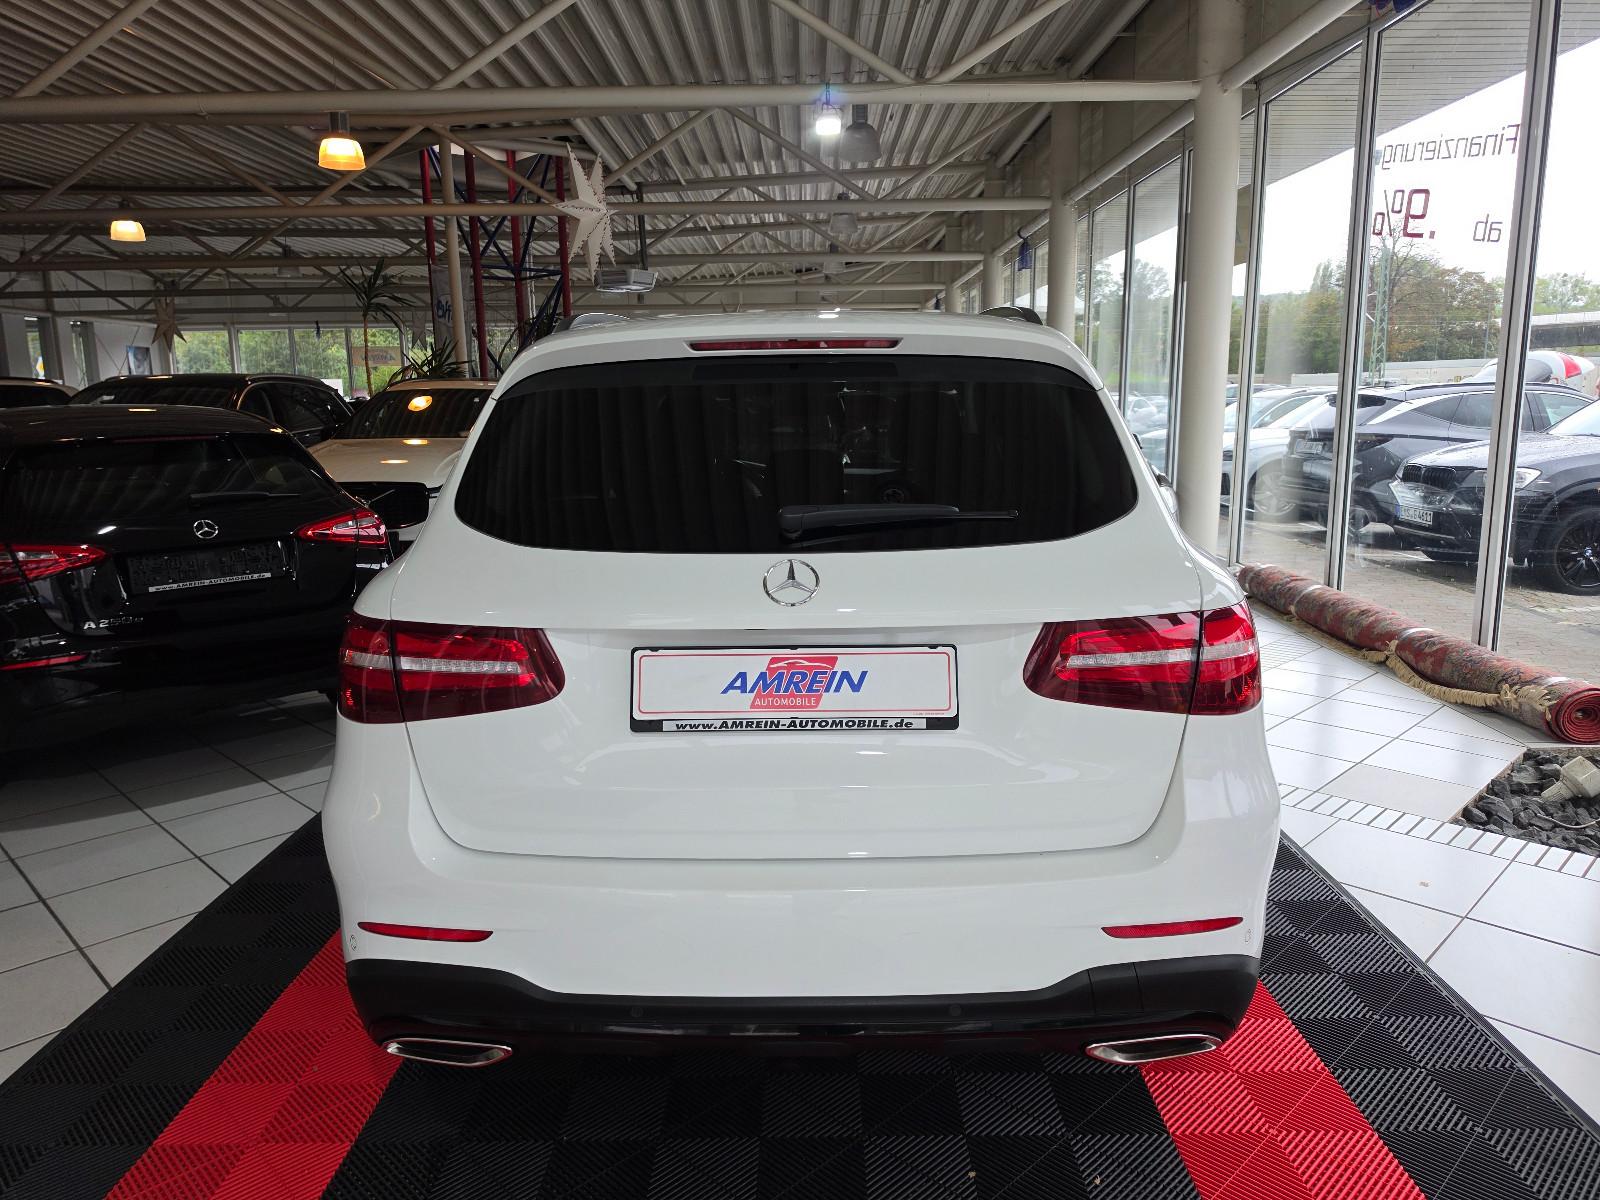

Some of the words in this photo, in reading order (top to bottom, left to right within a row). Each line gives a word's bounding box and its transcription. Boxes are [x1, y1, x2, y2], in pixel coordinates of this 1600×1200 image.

[83, 621, 97, 630] A
[720, 670, 869, 695] AMREIN
[754, 697, 817, 707] AUTOMOBILE
[675, 719, 914, 730] www.AMREIN-AUTOMOBILE.de
